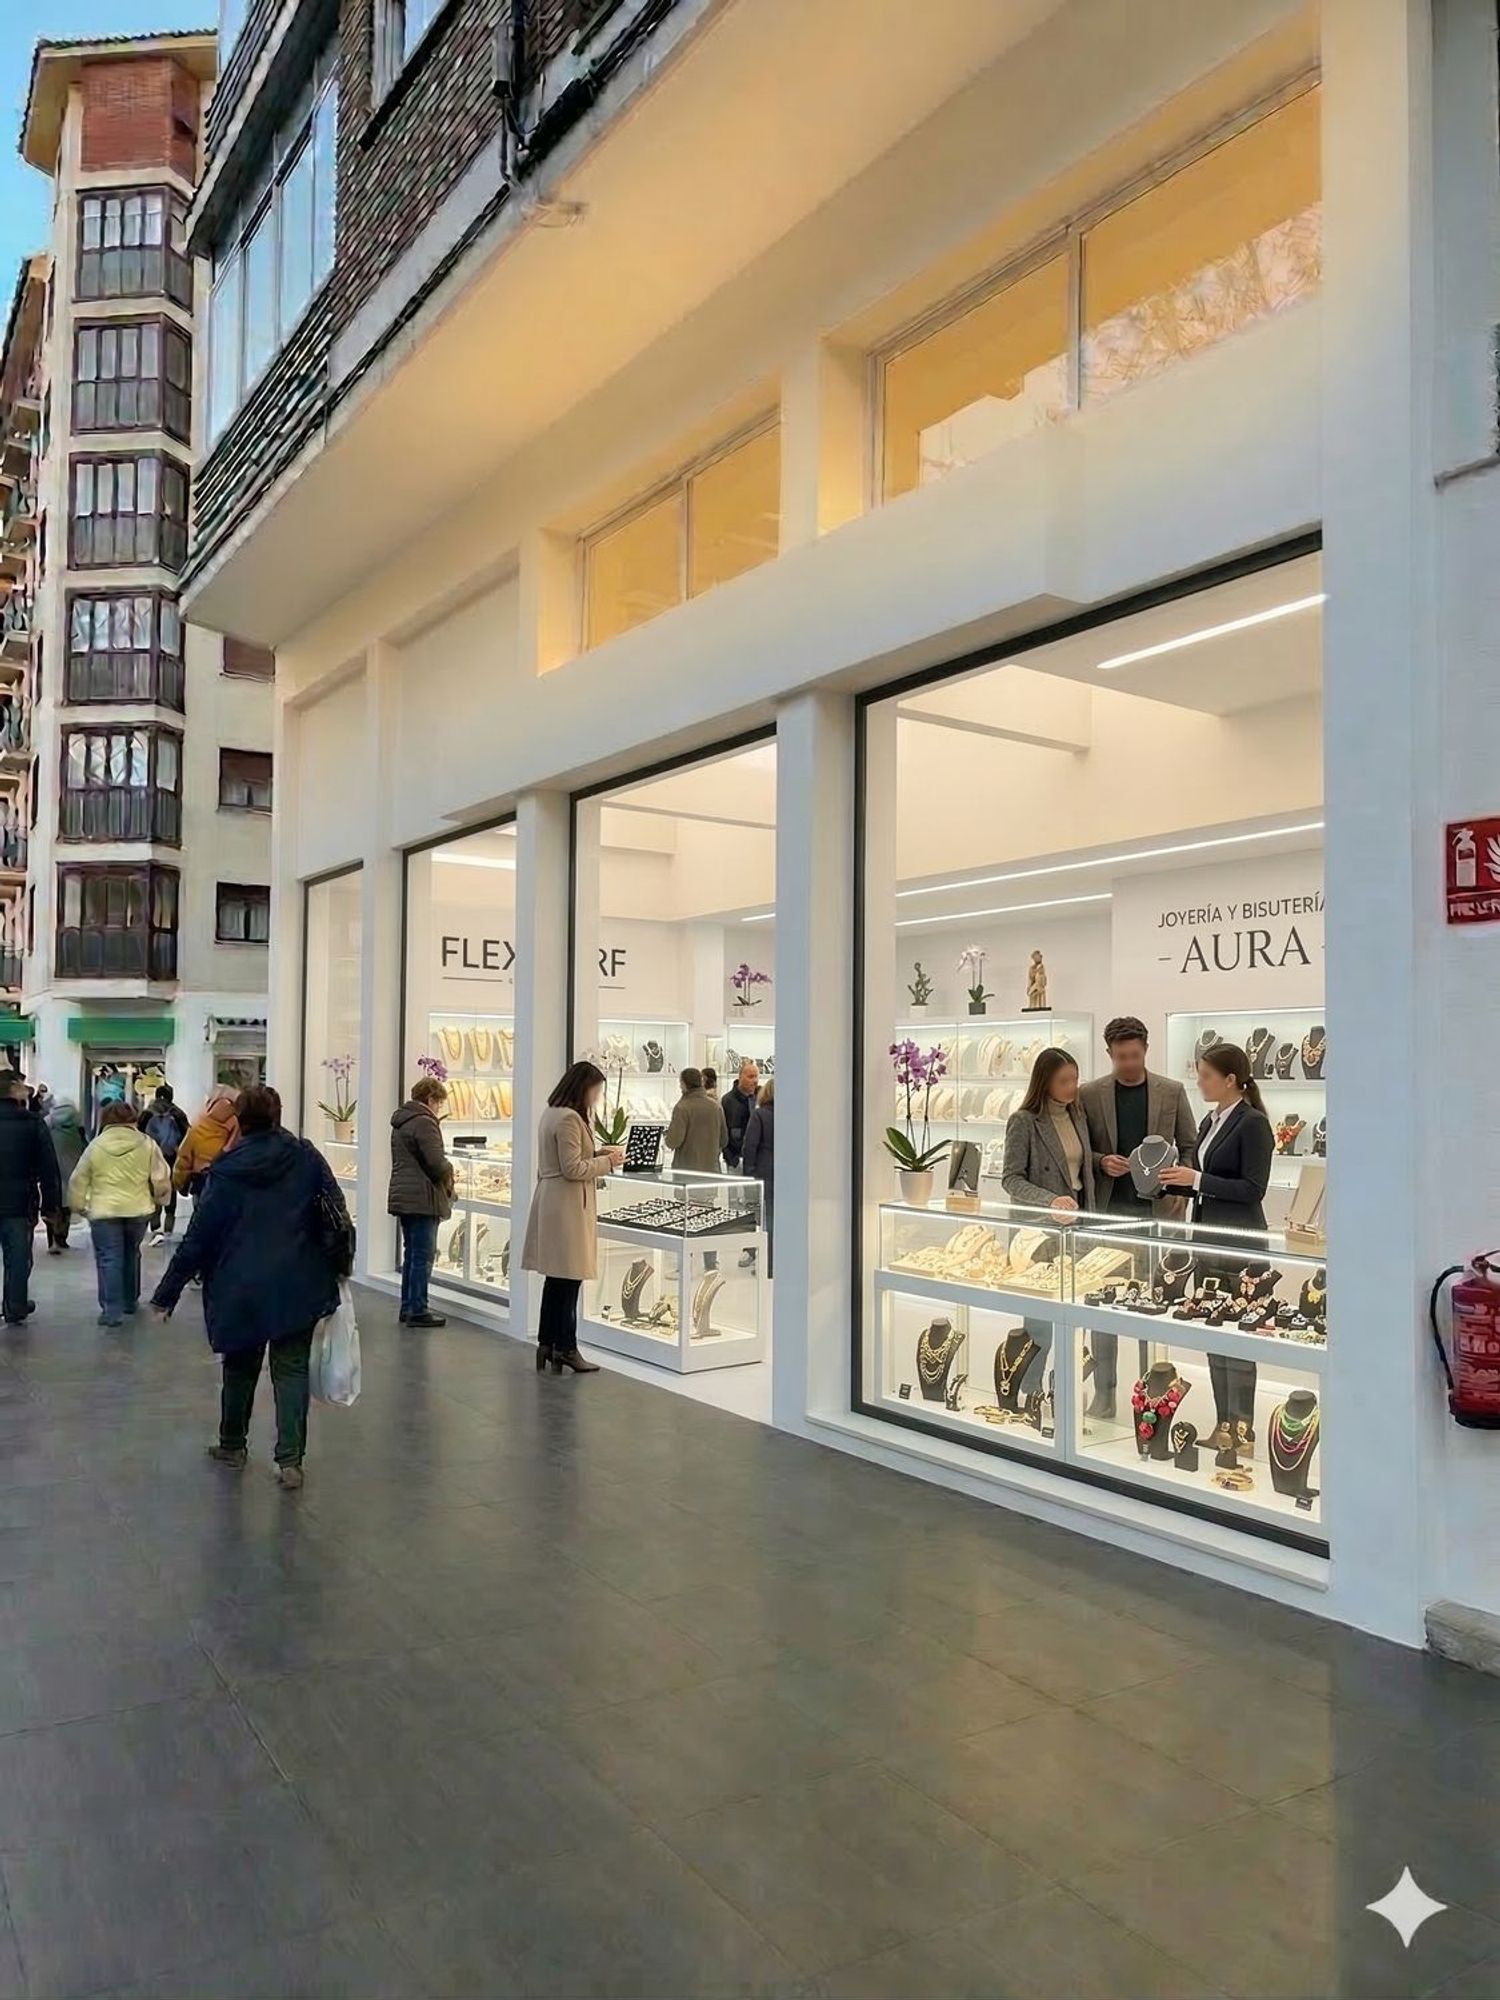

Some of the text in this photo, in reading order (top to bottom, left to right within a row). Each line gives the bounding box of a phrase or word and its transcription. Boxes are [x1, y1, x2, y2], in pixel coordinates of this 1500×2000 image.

[1158, 903, 1222, 928] JOYERÍA
[1227, 904, 1238, 920] Y
[1179, 925, 1312, 974] AURA
